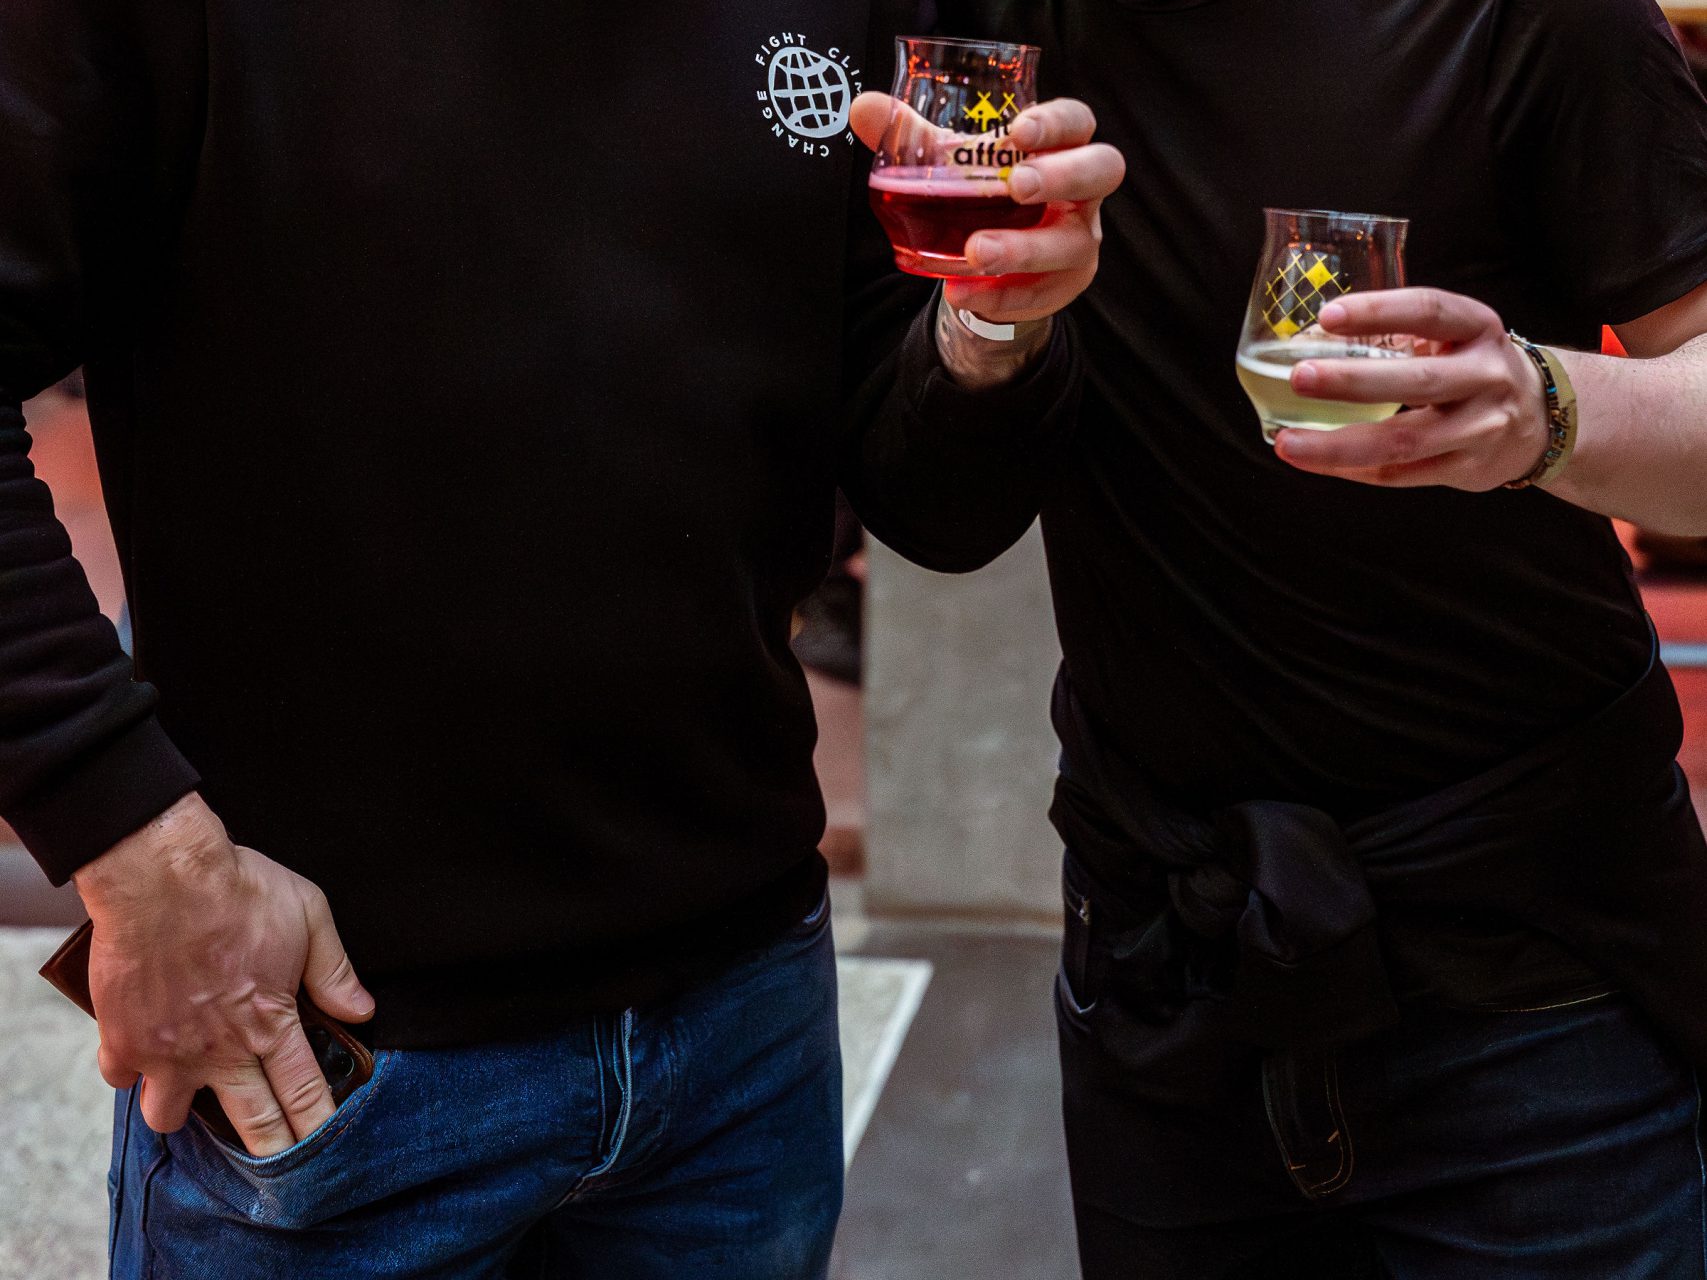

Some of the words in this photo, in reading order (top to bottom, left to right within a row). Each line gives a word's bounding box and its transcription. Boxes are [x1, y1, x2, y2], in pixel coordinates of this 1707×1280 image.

[755, 32, 807, 66] FIGHT
[756, 90, 830, 157] CHANGE
[828, 47, 863, 146] CLIME
